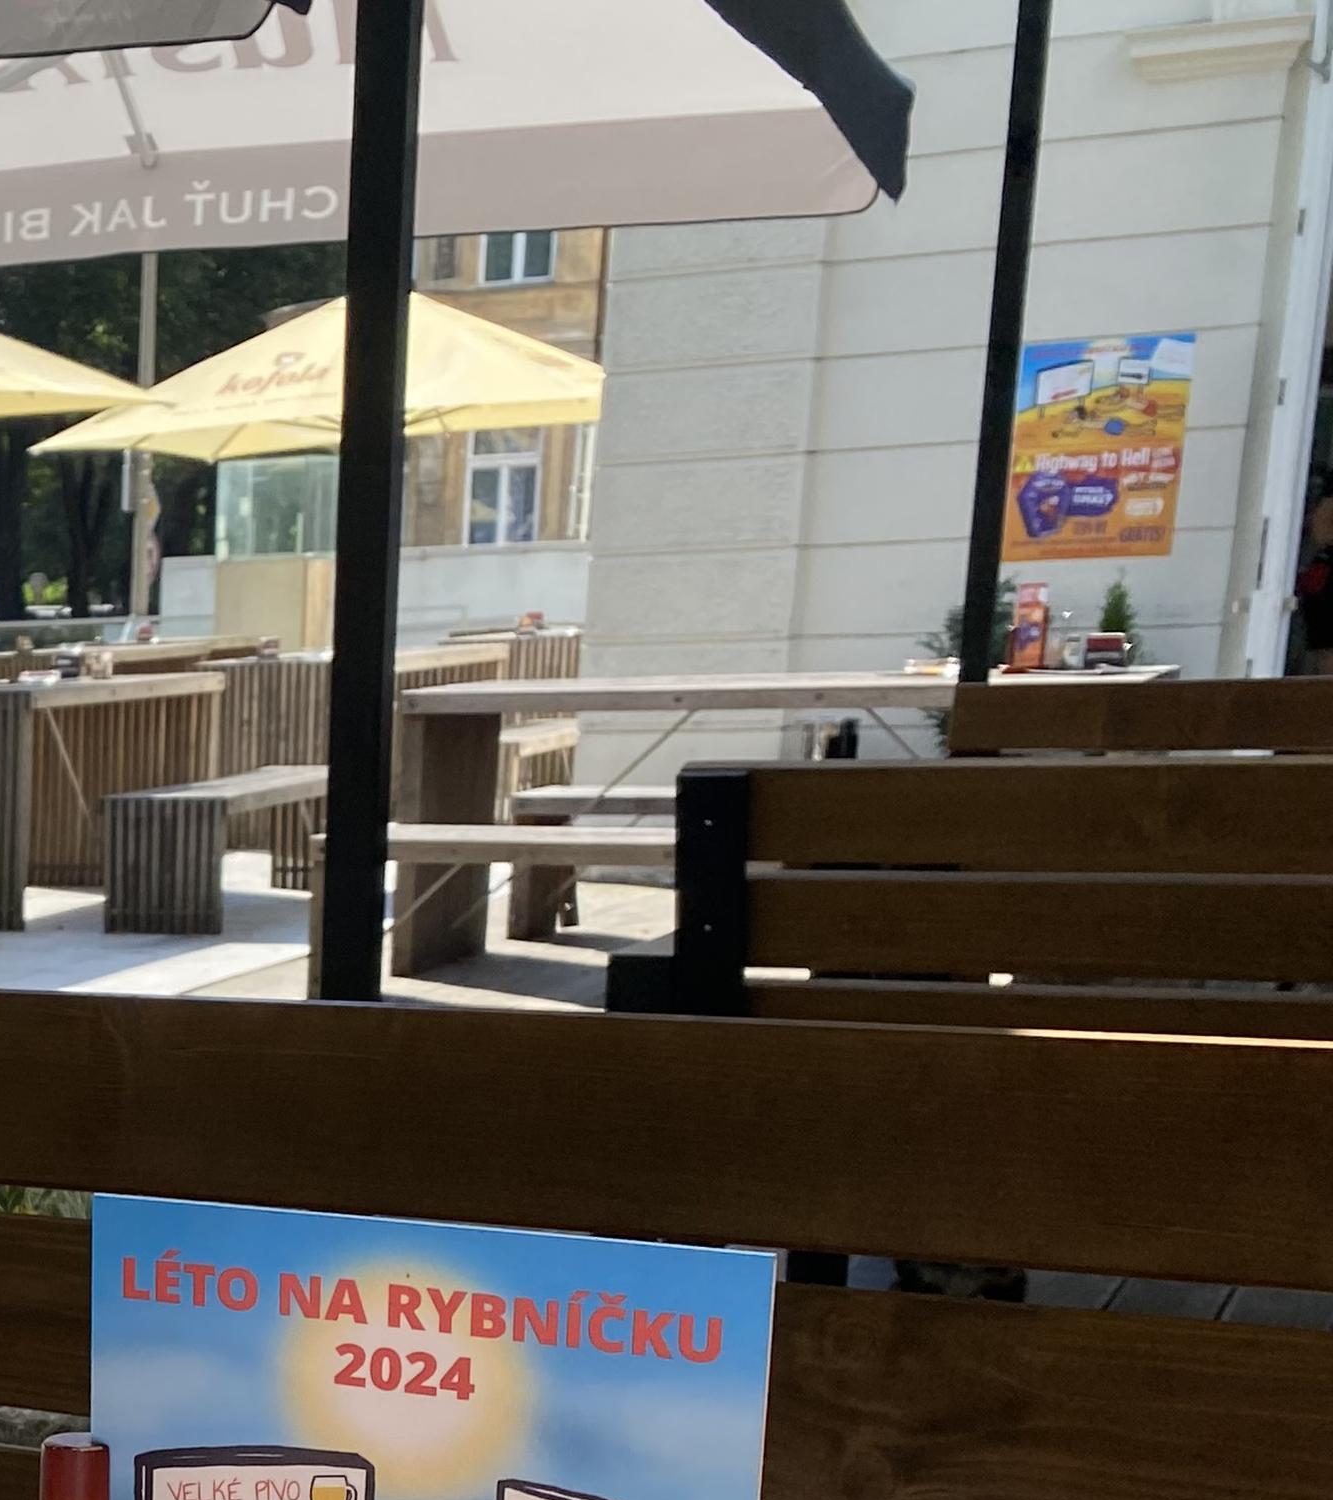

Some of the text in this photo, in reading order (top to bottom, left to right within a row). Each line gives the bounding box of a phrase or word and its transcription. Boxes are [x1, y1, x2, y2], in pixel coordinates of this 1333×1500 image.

[1099, 451, 1118, 468] to
[121, 1248, 724, 1364] LÉTO NA RYBNÍČKU
[333, 1342, 475, 1400] 2024
